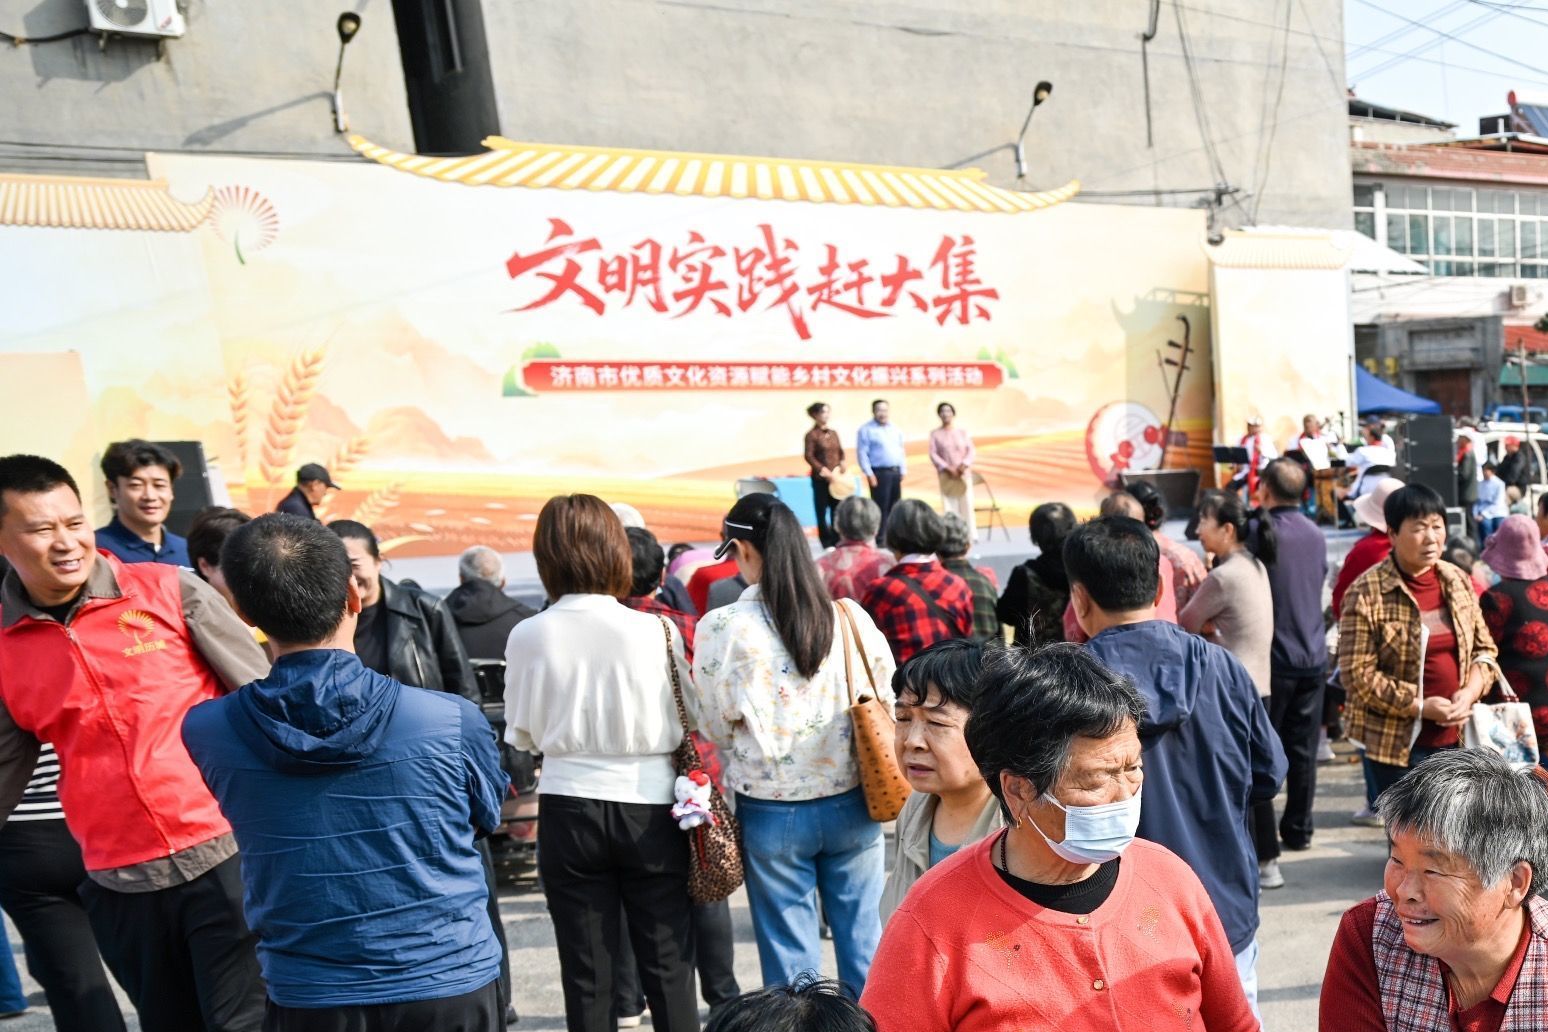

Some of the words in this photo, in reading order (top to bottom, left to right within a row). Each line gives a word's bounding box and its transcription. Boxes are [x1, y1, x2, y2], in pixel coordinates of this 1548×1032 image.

[502, 216, 1000, 340] 文明实践赶大集
